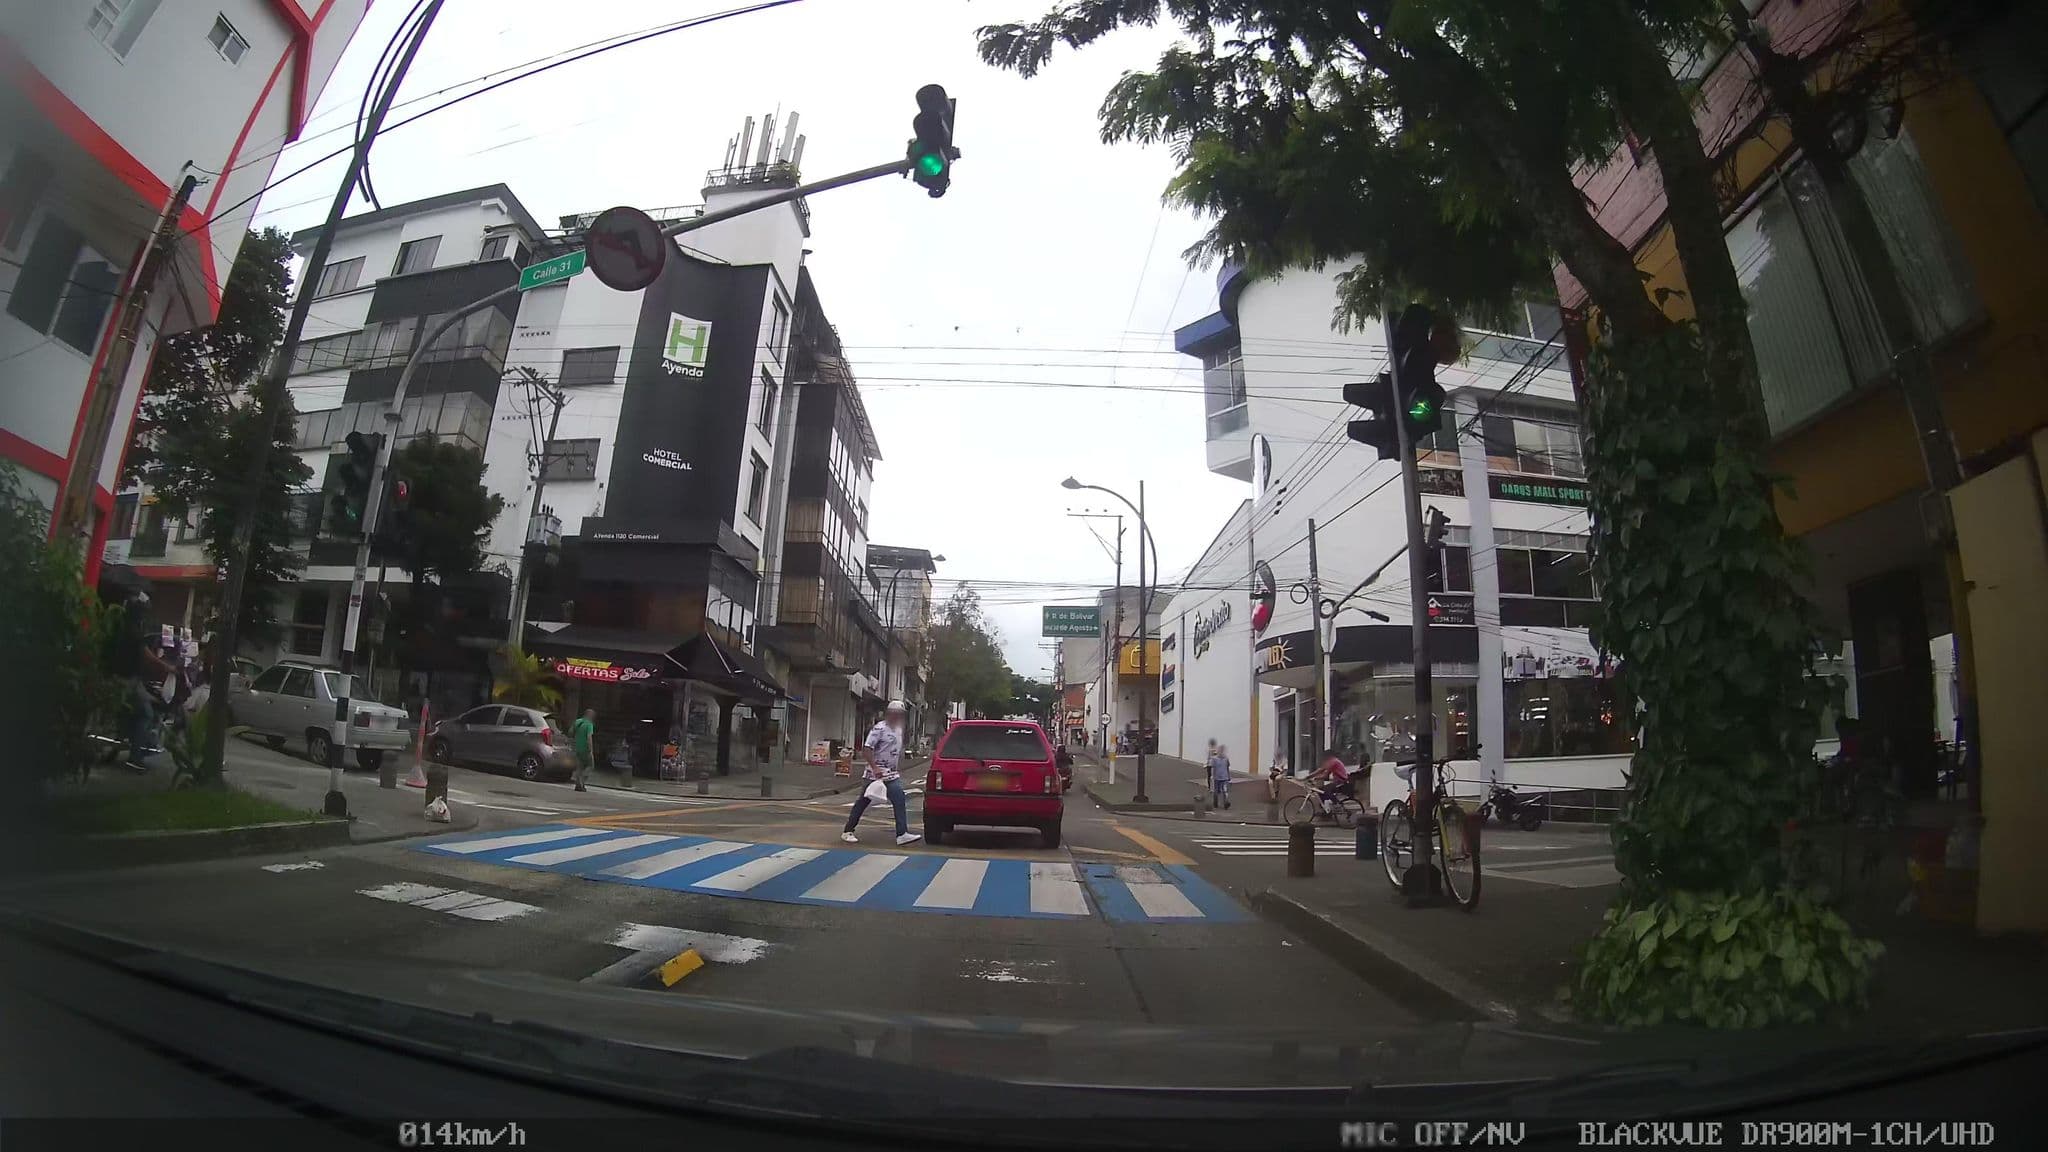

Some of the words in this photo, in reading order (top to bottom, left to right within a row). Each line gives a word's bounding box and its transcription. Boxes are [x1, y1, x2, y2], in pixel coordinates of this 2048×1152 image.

[532, 266, 557, 280] Calle
[560, 260, 571, 272] 31
[661, 360, 704, 377] Ayenda
[643, 453, 692, 470] COMERCIAL
[653, 448, 682, 461] HOTEL
[1533, 486, 1557, 498] MALL
[1559, 487, 1584, 500] SPORT
[557, 663, 618, 679] OFERTAS
